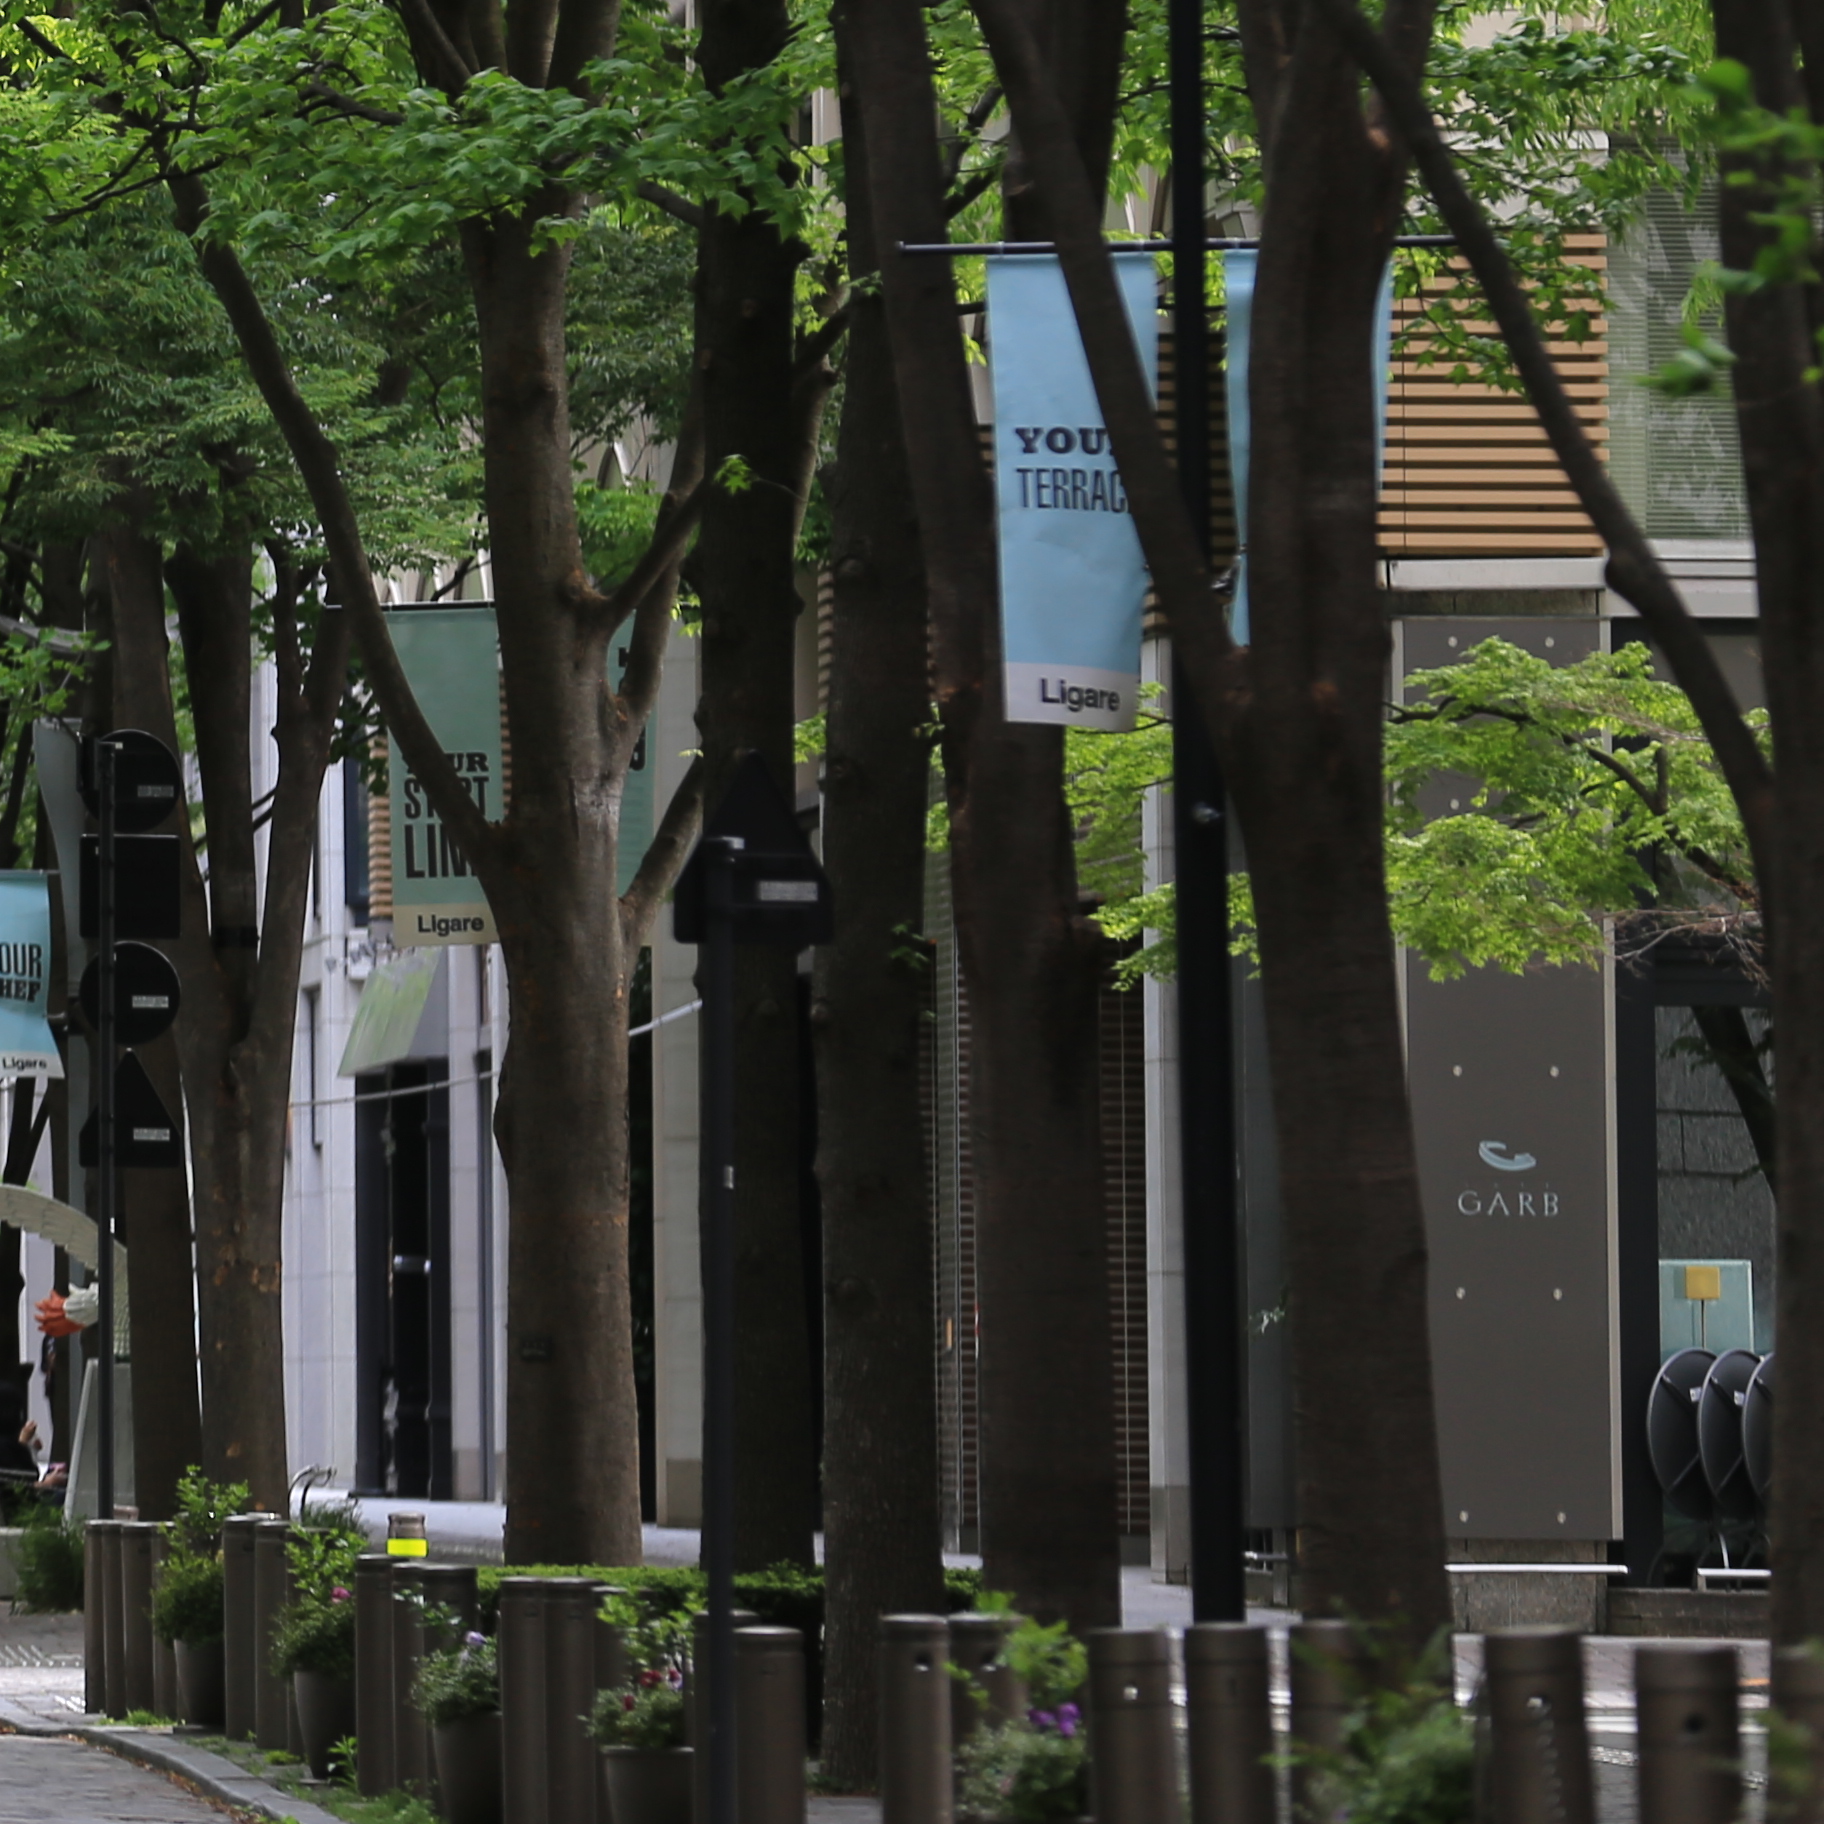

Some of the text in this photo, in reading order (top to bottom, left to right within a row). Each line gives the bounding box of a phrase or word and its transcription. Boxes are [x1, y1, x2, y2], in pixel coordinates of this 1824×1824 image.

[1015, 427, 1114, 455] YOU
[1015, 467, 1128, 513] TERRAC
[1040, 677, 1120, 713] Ligare
[404, 823, 478, 879] LIN
[417, 914, 485, 937] Ligare
[2, 1056, 48, 1071] Ligare
[1458, 1189, 1558, 1216] GARB
